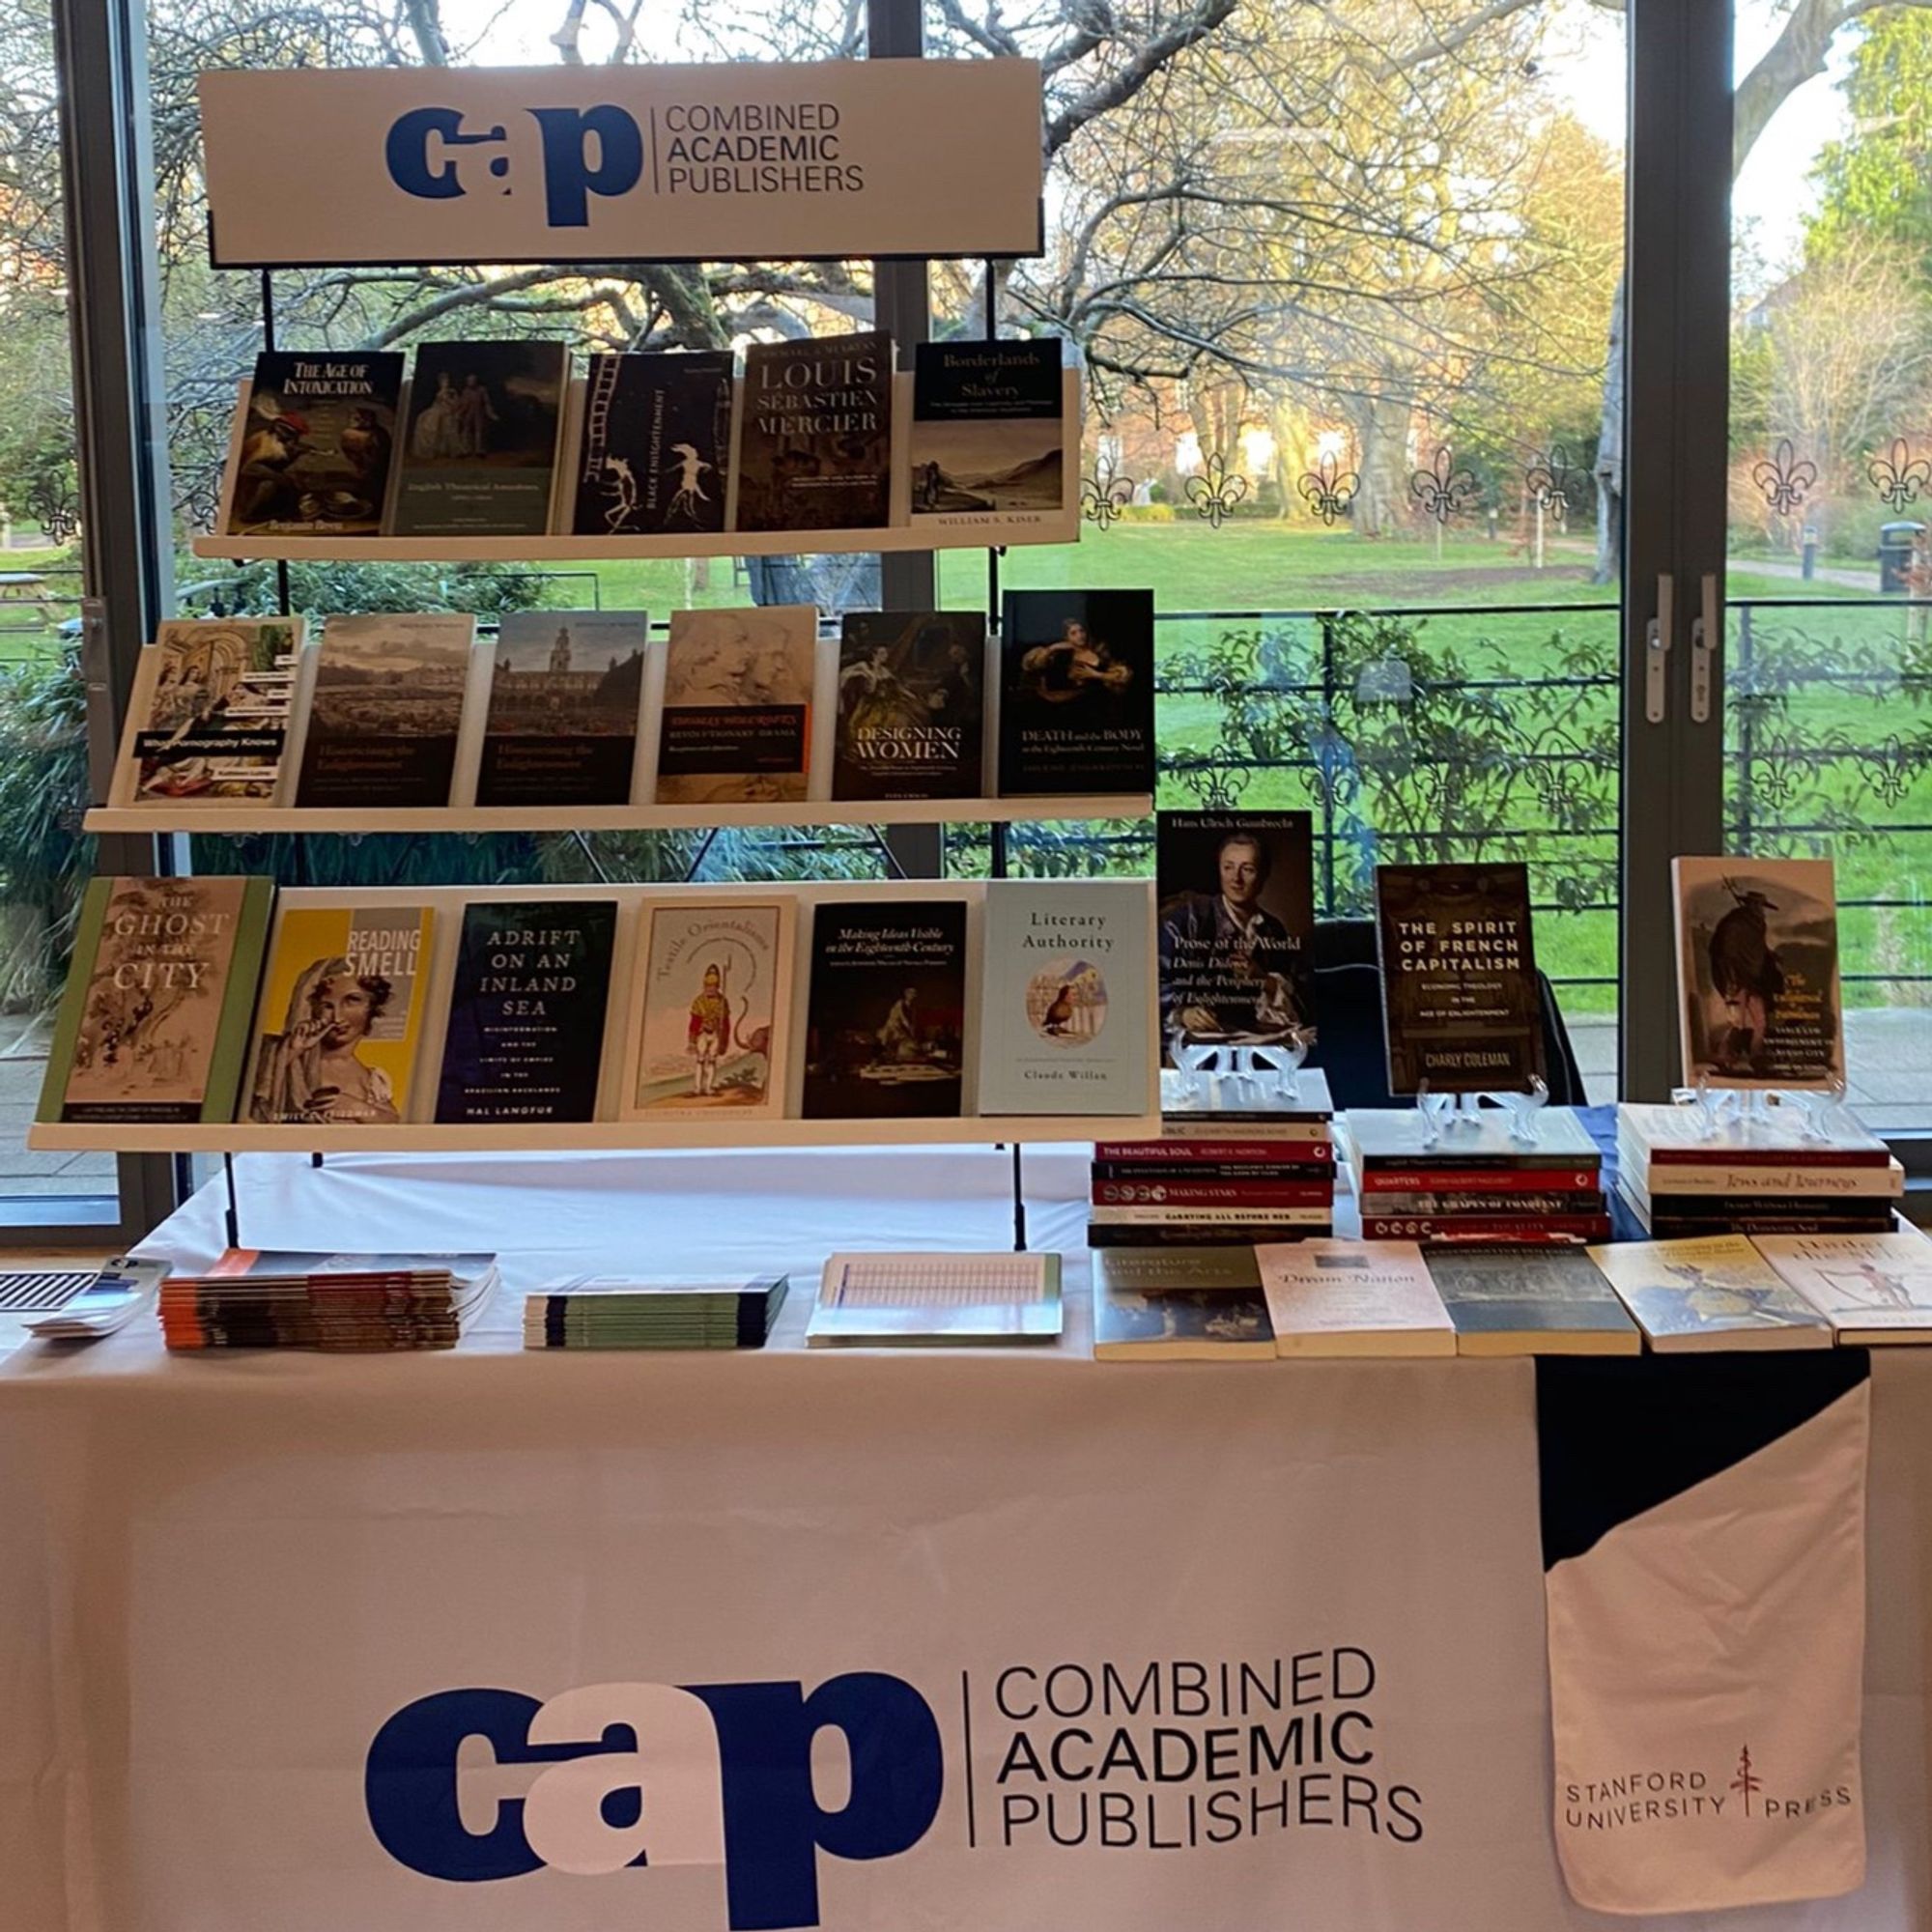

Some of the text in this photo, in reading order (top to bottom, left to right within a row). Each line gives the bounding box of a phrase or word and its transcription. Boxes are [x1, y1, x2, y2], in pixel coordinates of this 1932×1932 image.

[666, 104, 839, 131] COMBINED
[668, 134, 838, 162] ACADEMIC
[386, 103, 643, 228] cap
[668, 165, 865, 194] PUBLISHERS
[944, 352, 1040, 368] Borderlands
[323, 362, 348, 378] AGE
[350, 363, 370, 378] OF
[761, 356, 877, 389] LOUIS
[283, 379, 373, 395] INTOXICATION
[961, 384, 1019, 399] Slavery
[757, 412, 877, 435] MERCIER
[646, 476, 660, 509] BLACK
[857, 726, 962, 741] DESIGNING
[1022, 729, 1073, 742] DEATH
[1103, 728, 1143, 741] BODY
[856, 741, 960, 759] WOMEN
[1172, 817, 1294, 830] Hans Ulrich Gumbrecht
[114, 913, 230, 937] GHOST
[1031, 913, 1106, 930] Literary
[1399, 921, 1518, 935] THE SPIRIT
[347, 929, 421, 952] READING
[487, 929, 581, 946] ADRIFT
[1022, 934, 1114, 952] Authority
[1174, 937, 1211, 951] Prose
[1214, 936, 1232, 951] of
[1256, 935, 1301, 951] World
[1400, 939, 1520, 953] OF FRENCH
[343, 952, 417, 977] SMELL
[491, 953, 571, 969] ON AN
[1401, 956, 1520, 972] CAPITALISM
[113, 962, 210, 989] CITY
[479, 977, 577, 992] INLAND
[501, 1000, 546, 1015] SEA
[1463, 1051, 1511, 1068] COLEMAN
[1024, 1069, 1108, 1081] Claude Willan
[1104, 1147, 1121, 1156] THE
[1122, 1147, 1168, 1156] BEAUTIFUL
[1170, 1148, 1193, 1157] SOUL
[1726, 1173, 1758, 1188] Jews
[1761, 1172, 1790, 1187] and
[1794, 1173, 1858, 1190] Journeys
[995, 1646, 1377, 1721] COMBINED
[998, 1712, 1376, 1785] ACADEMIC
[1566, 1772, 1707, 1804] STANFORD
[364, 1670, 944, 1931] cap
[1565, 1787, 1852, 1830] UNIVERSITY PRESS
[1002, 1774, 1425, 1849] PUBLISHERS
